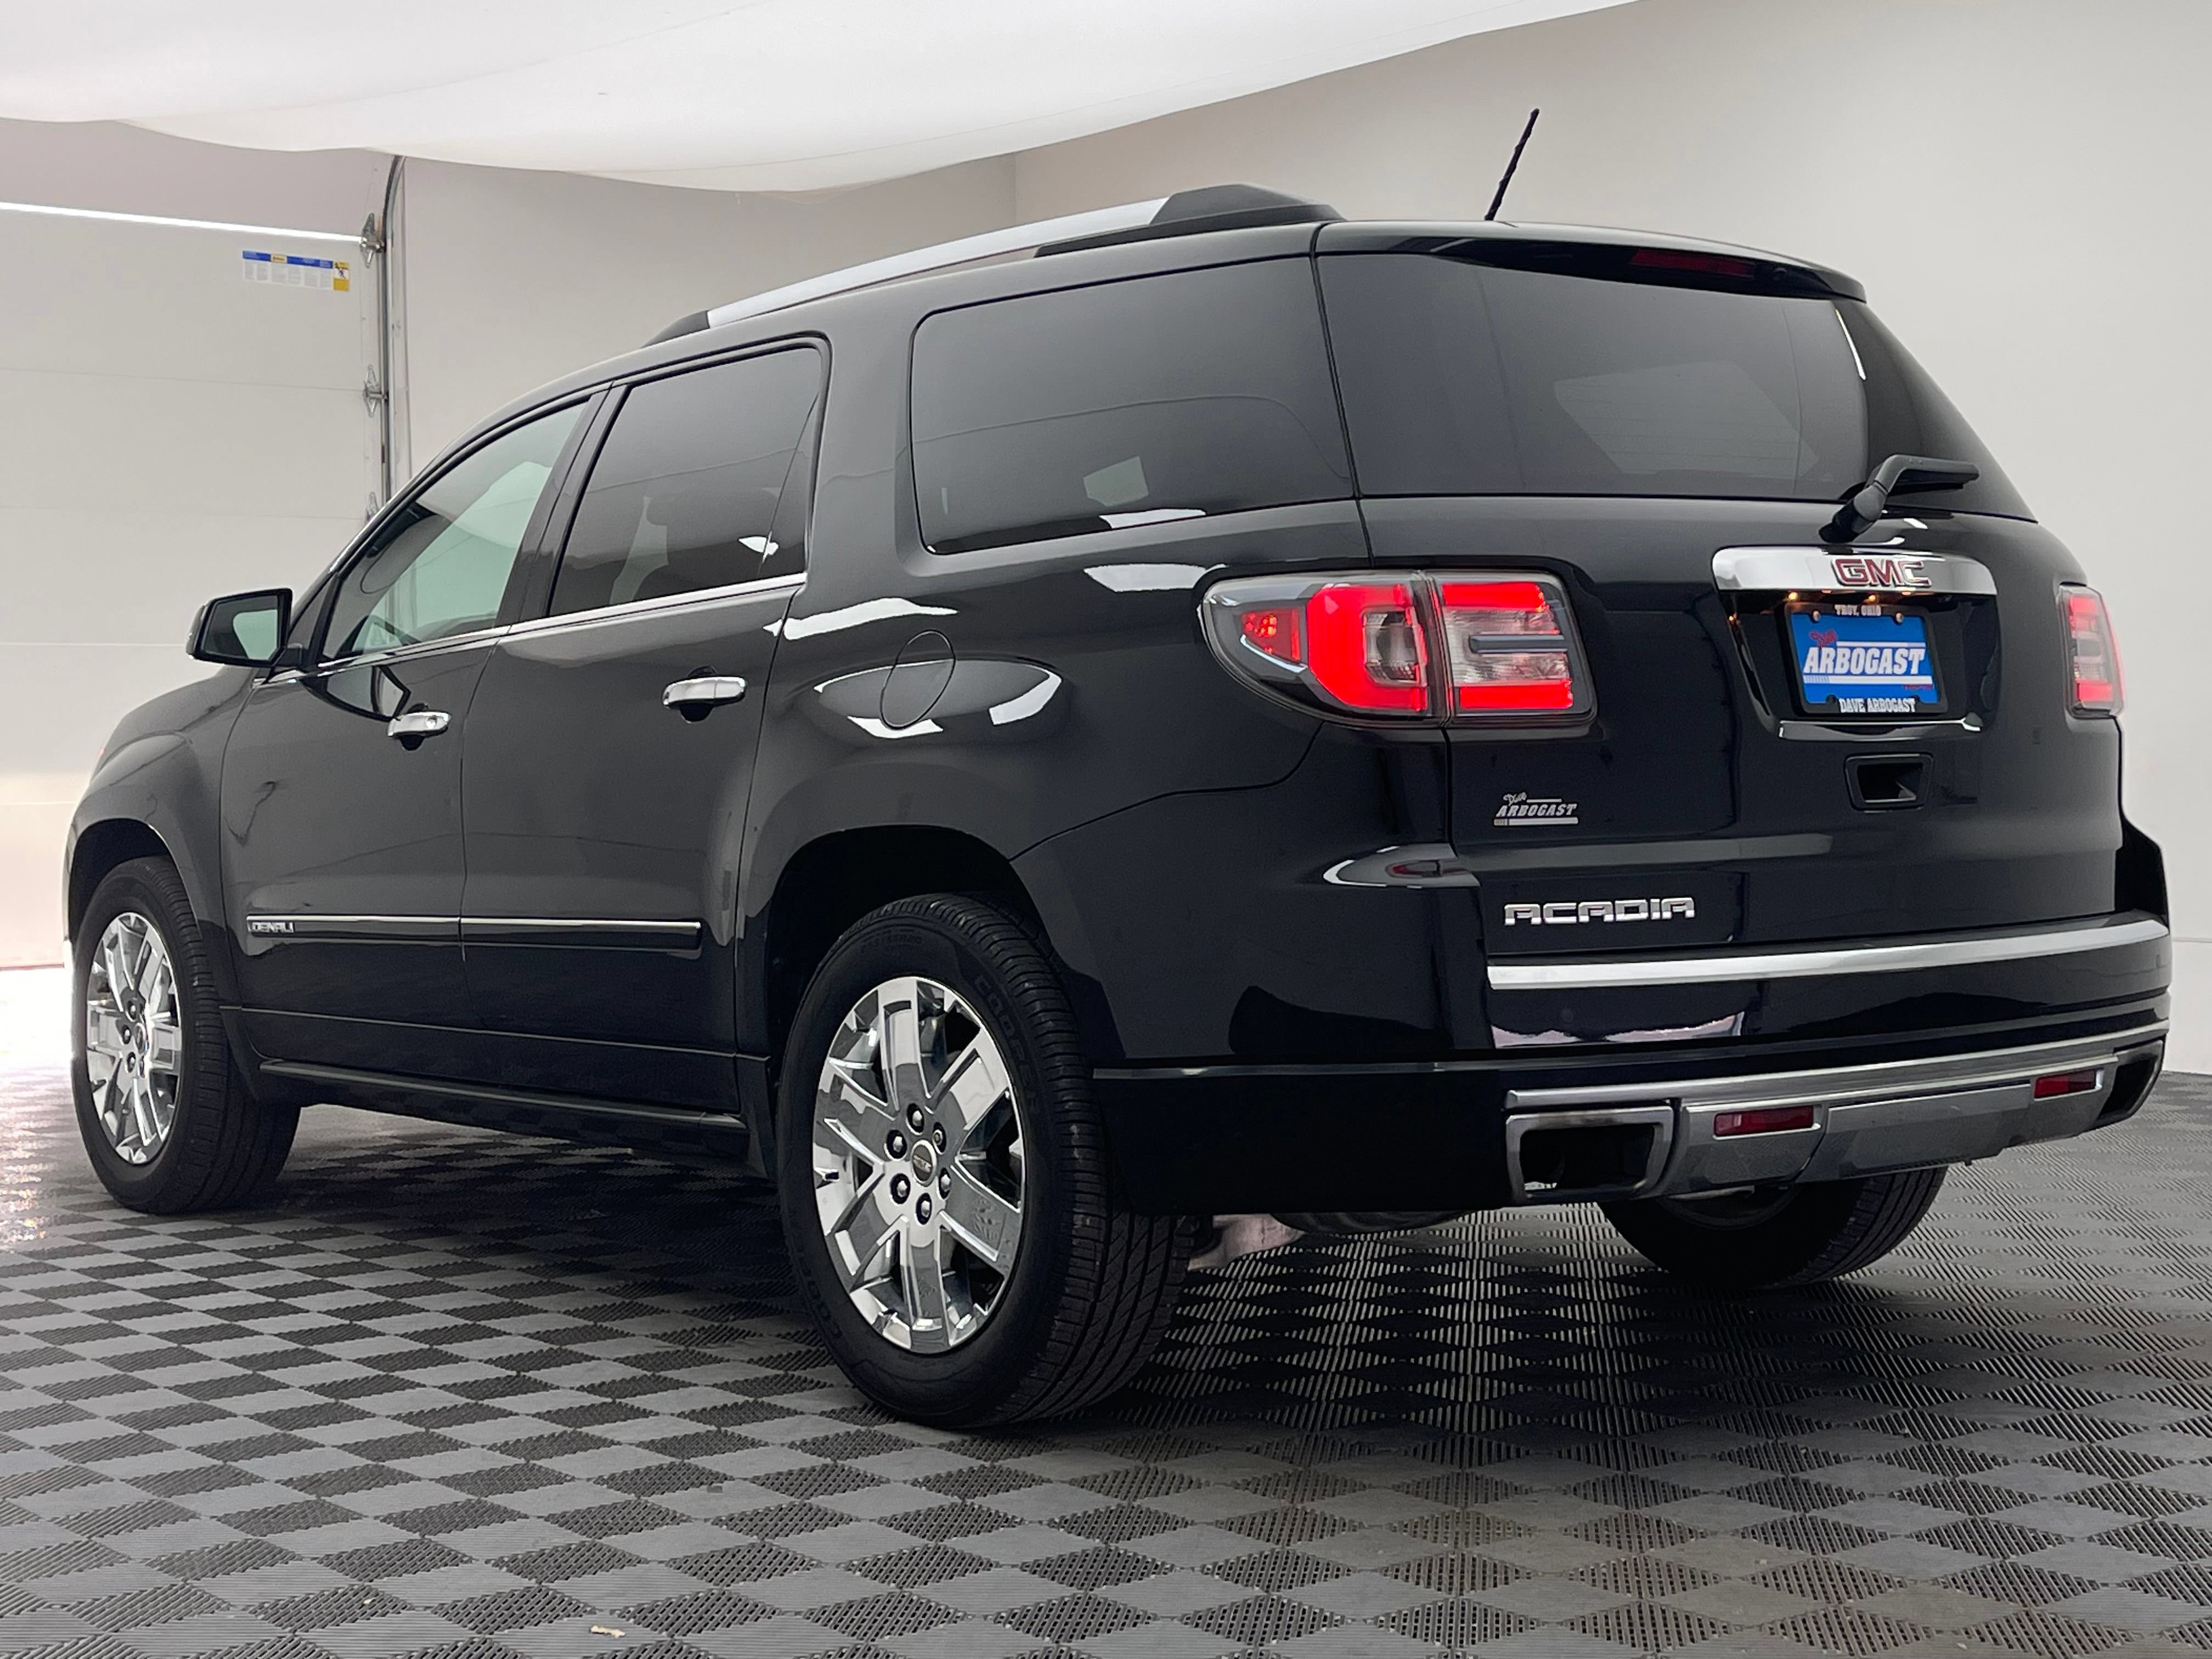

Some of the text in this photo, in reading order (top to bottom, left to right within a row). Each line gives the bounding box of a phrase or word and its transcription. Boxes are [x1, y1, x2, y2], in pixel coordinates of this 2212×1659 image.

[1832, 557, 1932, 587] GMC
[1861, 605, 1882, 616] OHIO
[1803, 647, 1926, 675] ARBOGAST
[1838, 698, 1916, 713] DAVE ARBOGAST
[1496, 803, 1577, 817] ARBOGAST
[1504, 896, 1695, 926] ACADIA
[252, 922, 294, 933] DENALI
